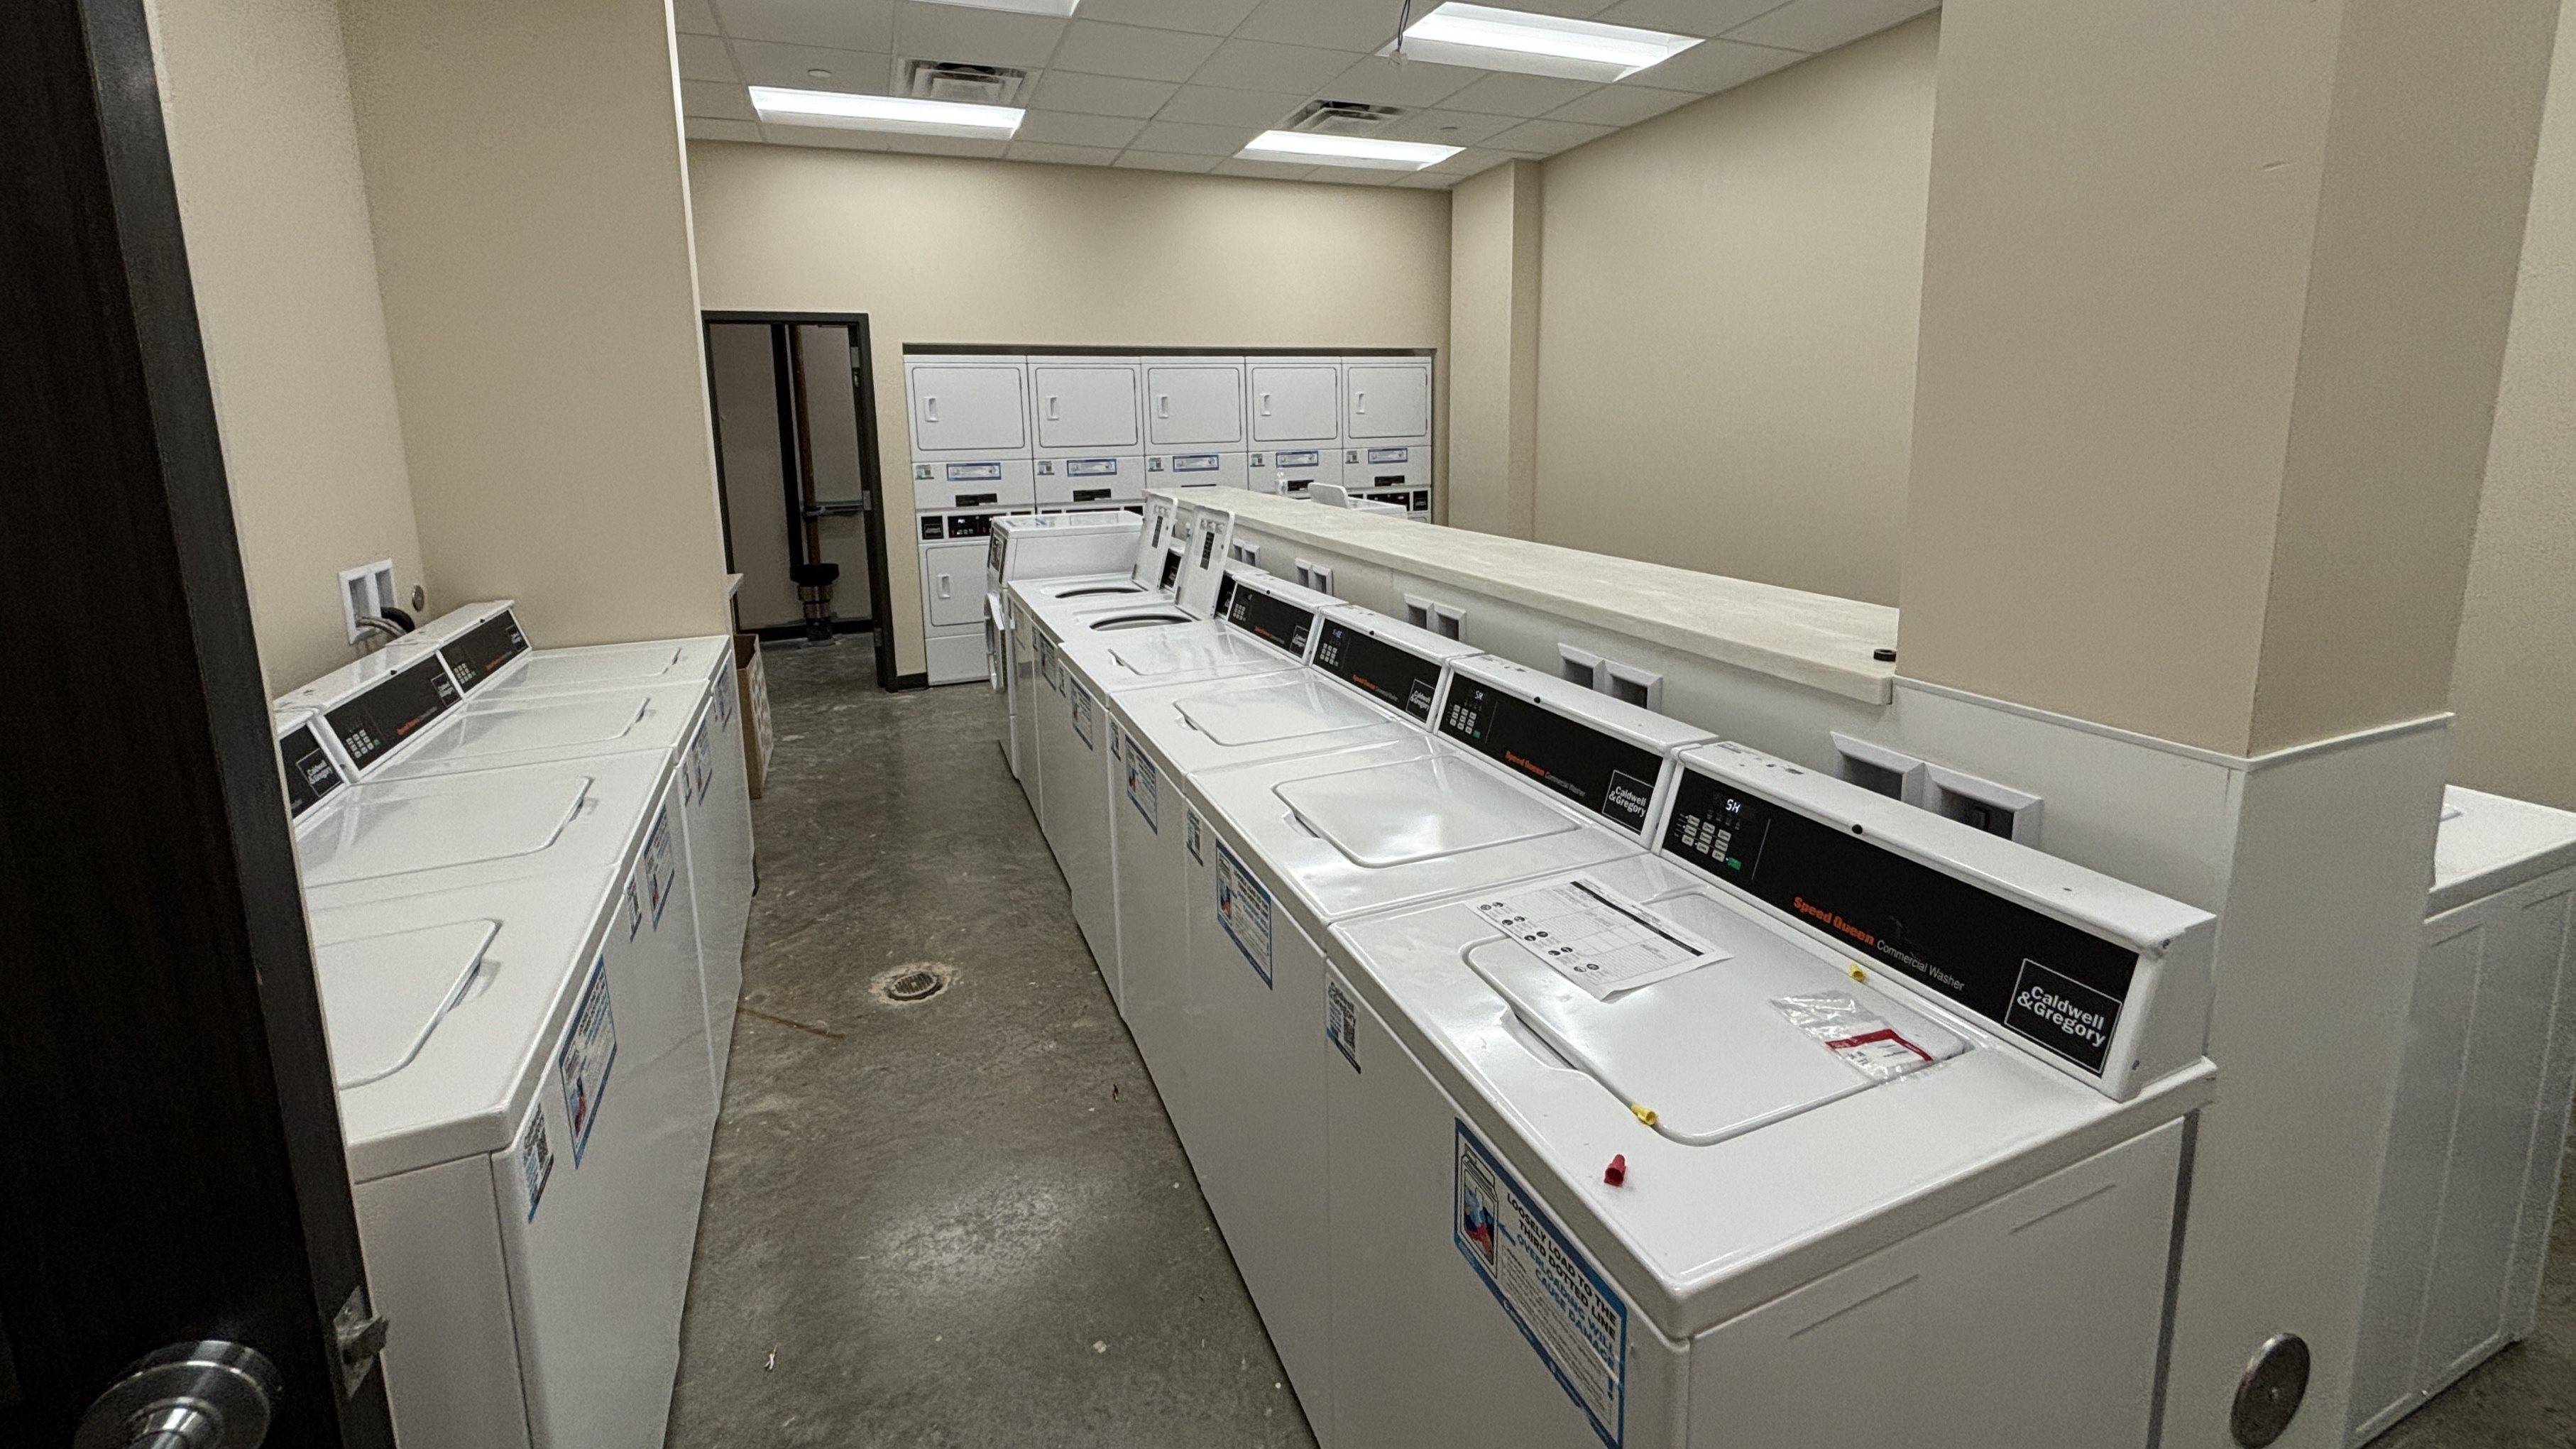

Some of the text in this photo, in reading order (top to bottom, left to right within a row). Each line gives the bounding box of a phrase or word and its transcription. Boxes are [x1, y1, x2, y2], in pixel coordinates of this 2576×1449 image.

[1608, 791, 1646, 817] &Gregory
[1615, 786, 1646, 806] Caldwell
[1793, 896, 1966, 993] Speed Queen Commercial Washer
[2017, 990, 2106, 1047] &Gregory
[2031, 985, 2105, 1030] Caldwell
[1507, 1192, 1616, 1326] LOOSELY LOAD TO THE
[1519, 1219, 1616, 1341] THIRD DOTTED LINE
[1516, 1233, 1585, 1320] OVERLOADING
[1587, 1316, 1613, 1355] WILL
[1535, 1268, 1566, 1313] CAUSE
